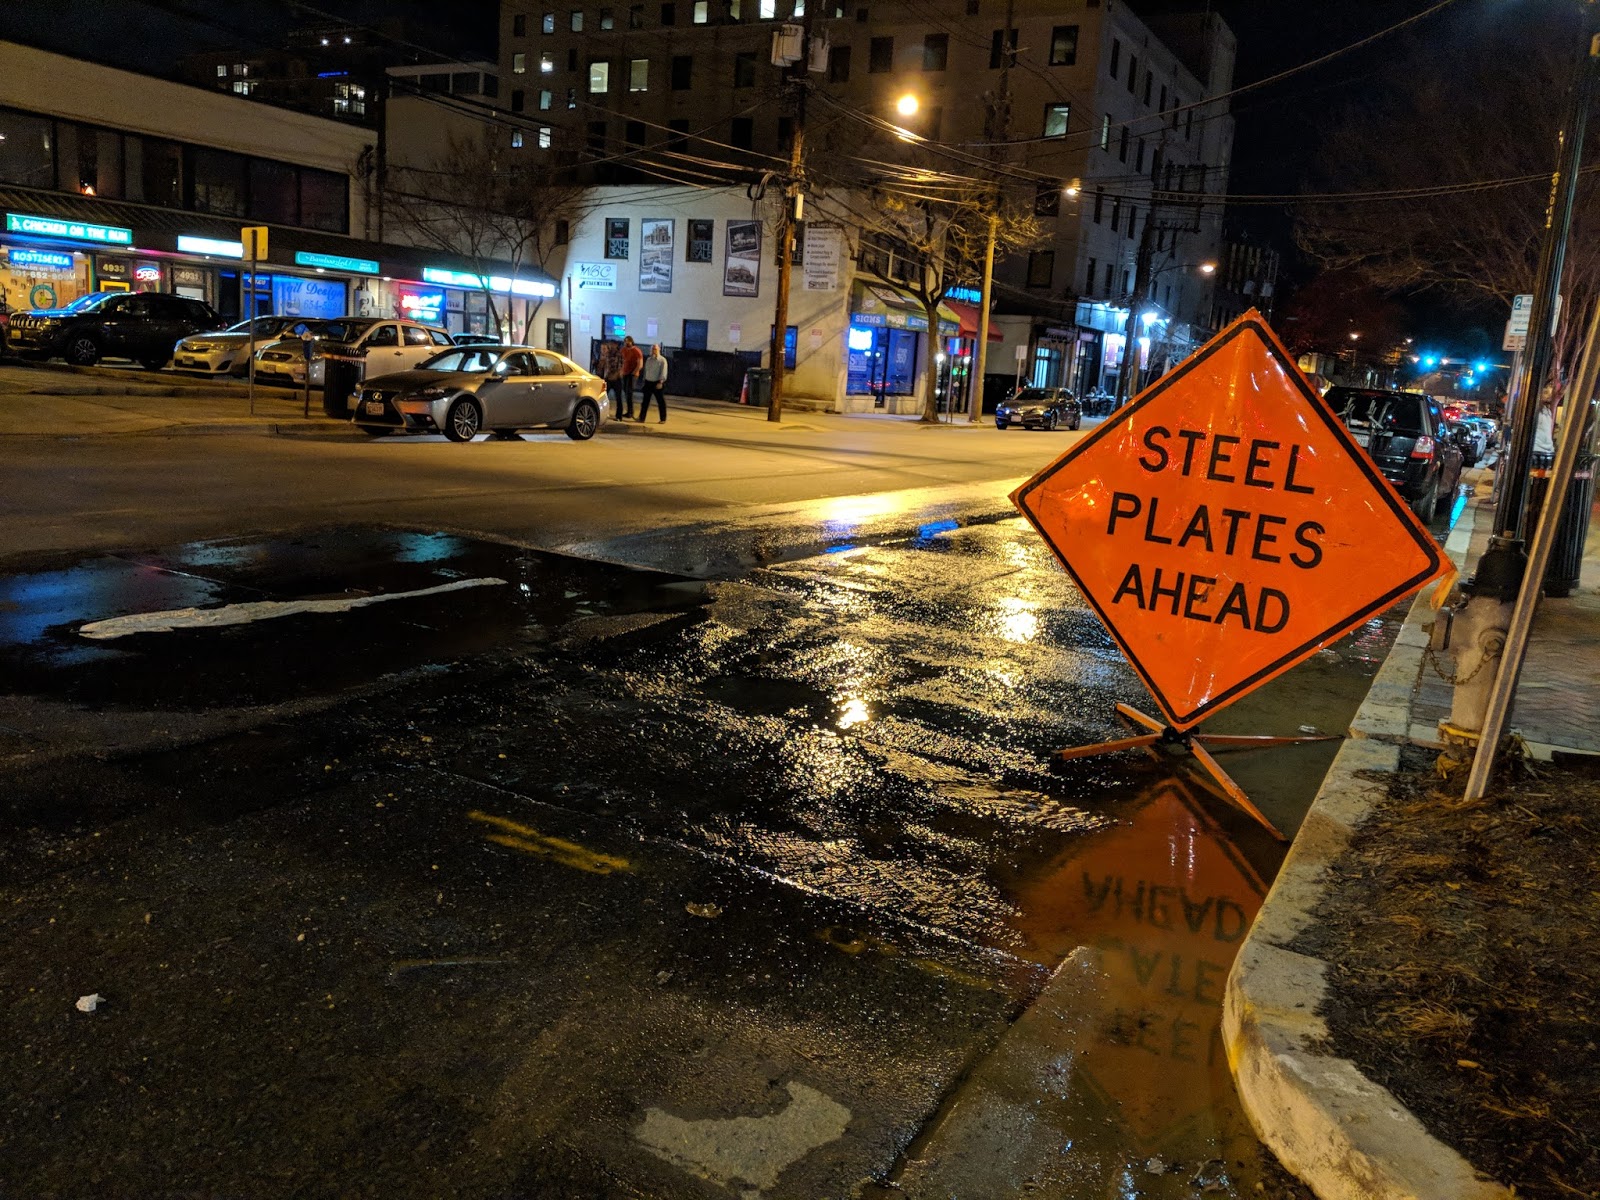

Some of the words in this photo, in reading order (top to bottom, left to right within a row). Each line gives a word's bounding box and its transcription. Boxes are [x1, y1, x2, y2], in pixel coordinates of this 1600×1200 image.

[23, 219, 67, 234] CHICKEN
[69, 225, 84, 236] ON
[86, 227, 105, 239] THE
[107, 230, 128, 242] RUN
[13, 252, 70, 266] ROSTISERIA
[102, 263, 125, 273] 4933
[136, 270, 160, 281] OPEN
[180, 271, 199, 281] 4931
[855, 315, 881, 324] SIGNS
[1138, 425, 1315, 494] STEEL
[1106, 491, 1325, 569] PLATES
[1112, 563, 1290, 634] AHEAD
